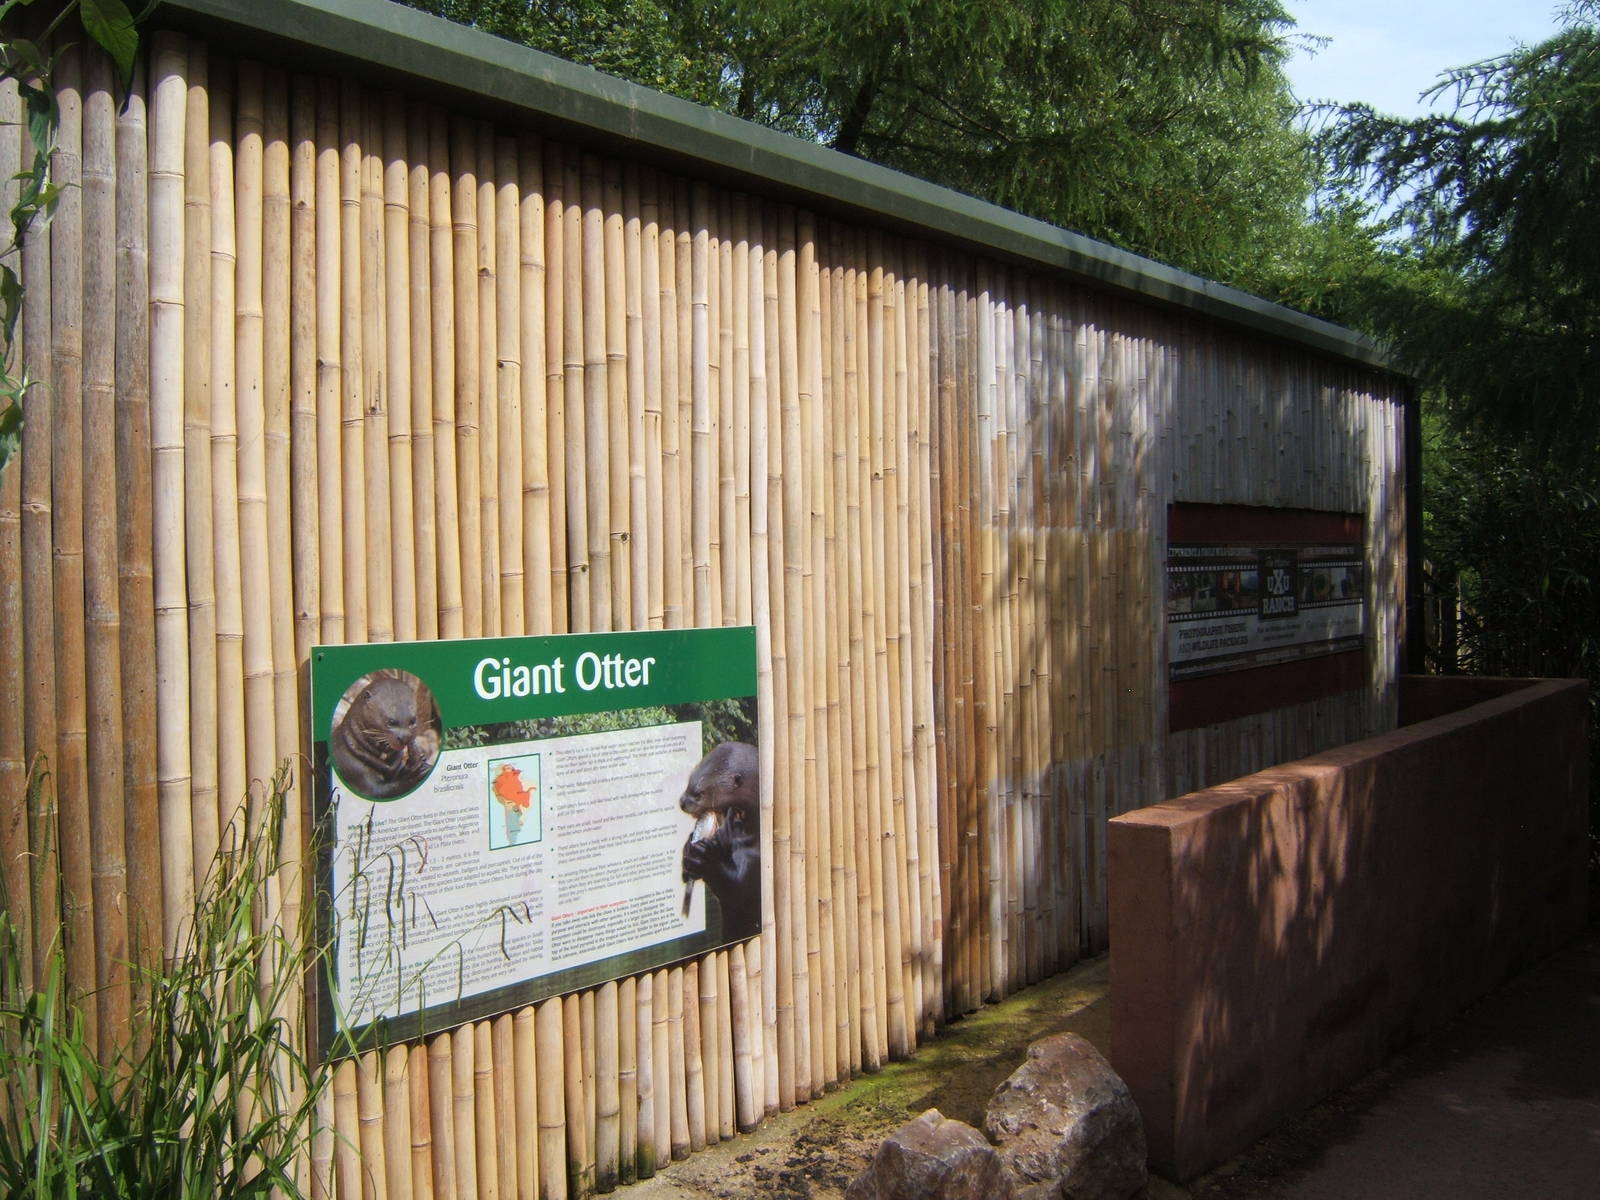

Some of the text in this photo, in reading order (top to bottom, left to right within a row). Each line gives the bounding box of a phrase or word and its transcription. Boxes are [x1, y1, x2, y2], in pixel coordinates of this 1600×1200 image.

[1263, 596, 1295, 614] RANCH
[474, 651, 656, 700] Giant Otter
[447, 762, 478, 772] Giant Otter
